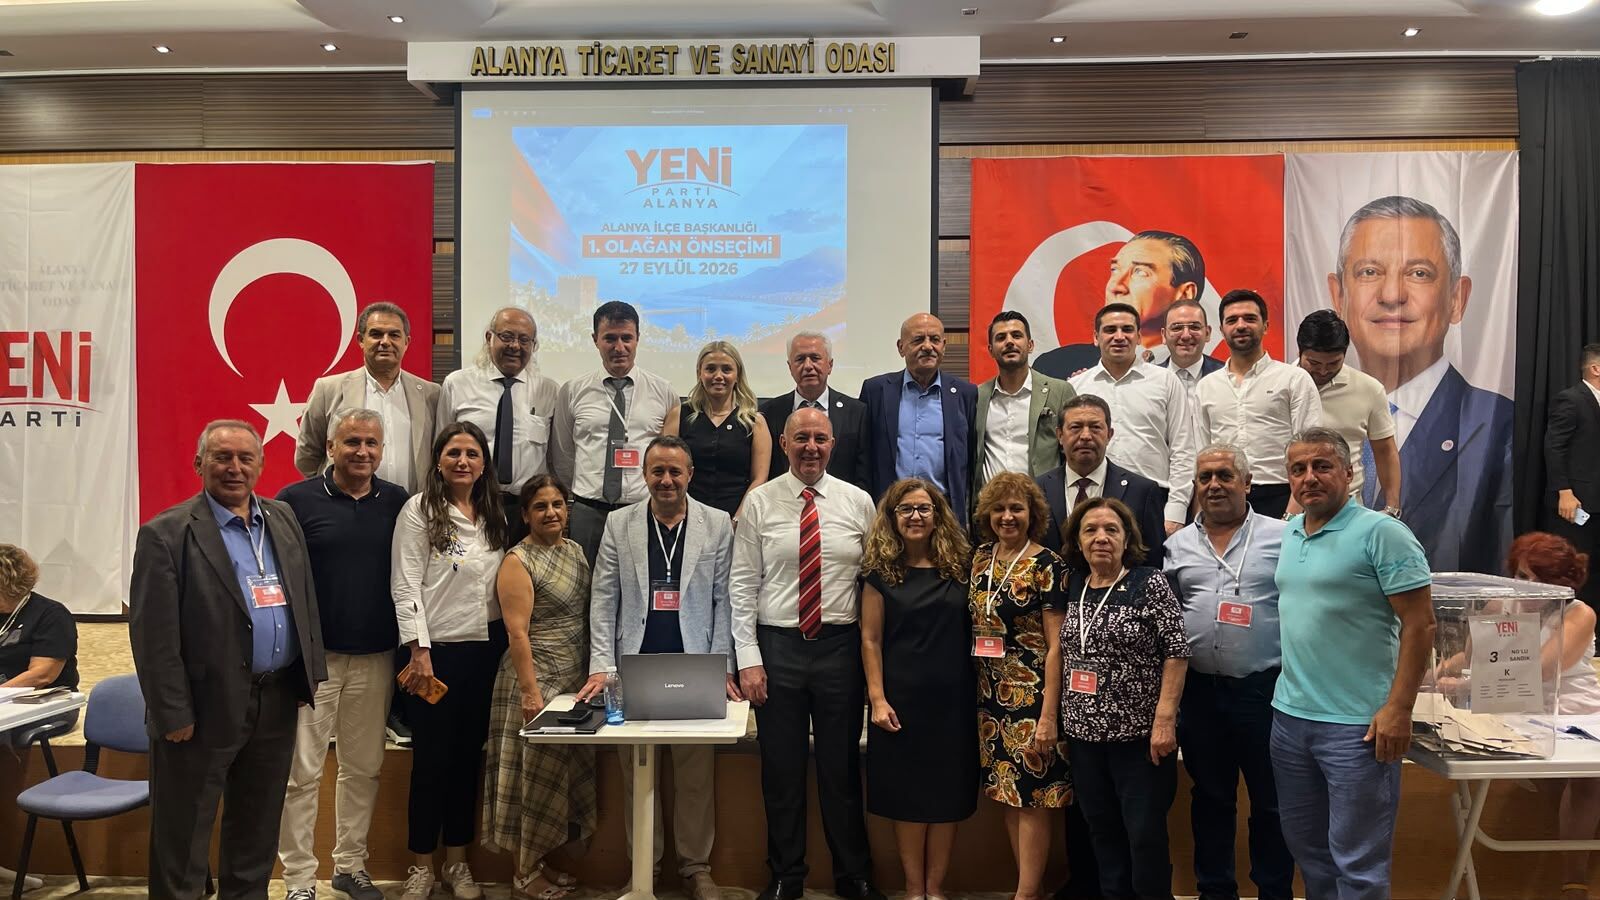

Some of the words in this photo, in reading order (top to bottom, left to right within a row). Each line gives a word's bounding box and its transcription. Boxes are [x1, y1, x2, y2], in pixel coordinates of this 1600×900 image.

[471, 46, 567, 76] ALANYA
[577, 41, 679, 76] TİCARET
[689, 45, 721, 75] VE
[732, 37, 815, 75] SANAYİ
[825, 42, 896, 73] ODASI
[643, 199, 718, 208] ALANYA
[601, 223, 651, 232] ALANYA
[654, 220, 680, 235] İLÇE
[684, 221, 757, 235] BAŞKANLIĞI
[588, 240, 600, 254] 1.
[605, 236, 682, 254] OLAĞAN
[687, 236, 773, 257] ÖNSEÇİMİ
[619, 262, 638, 275] 27
[644, 259, 695, 275] EYLÜL
[699, 262, 738, 275] 2026
[0, 331, 92, 403] ENi
[0, 411, 81, 427] ARTi
[1489, 651, 1498, 663] 3
